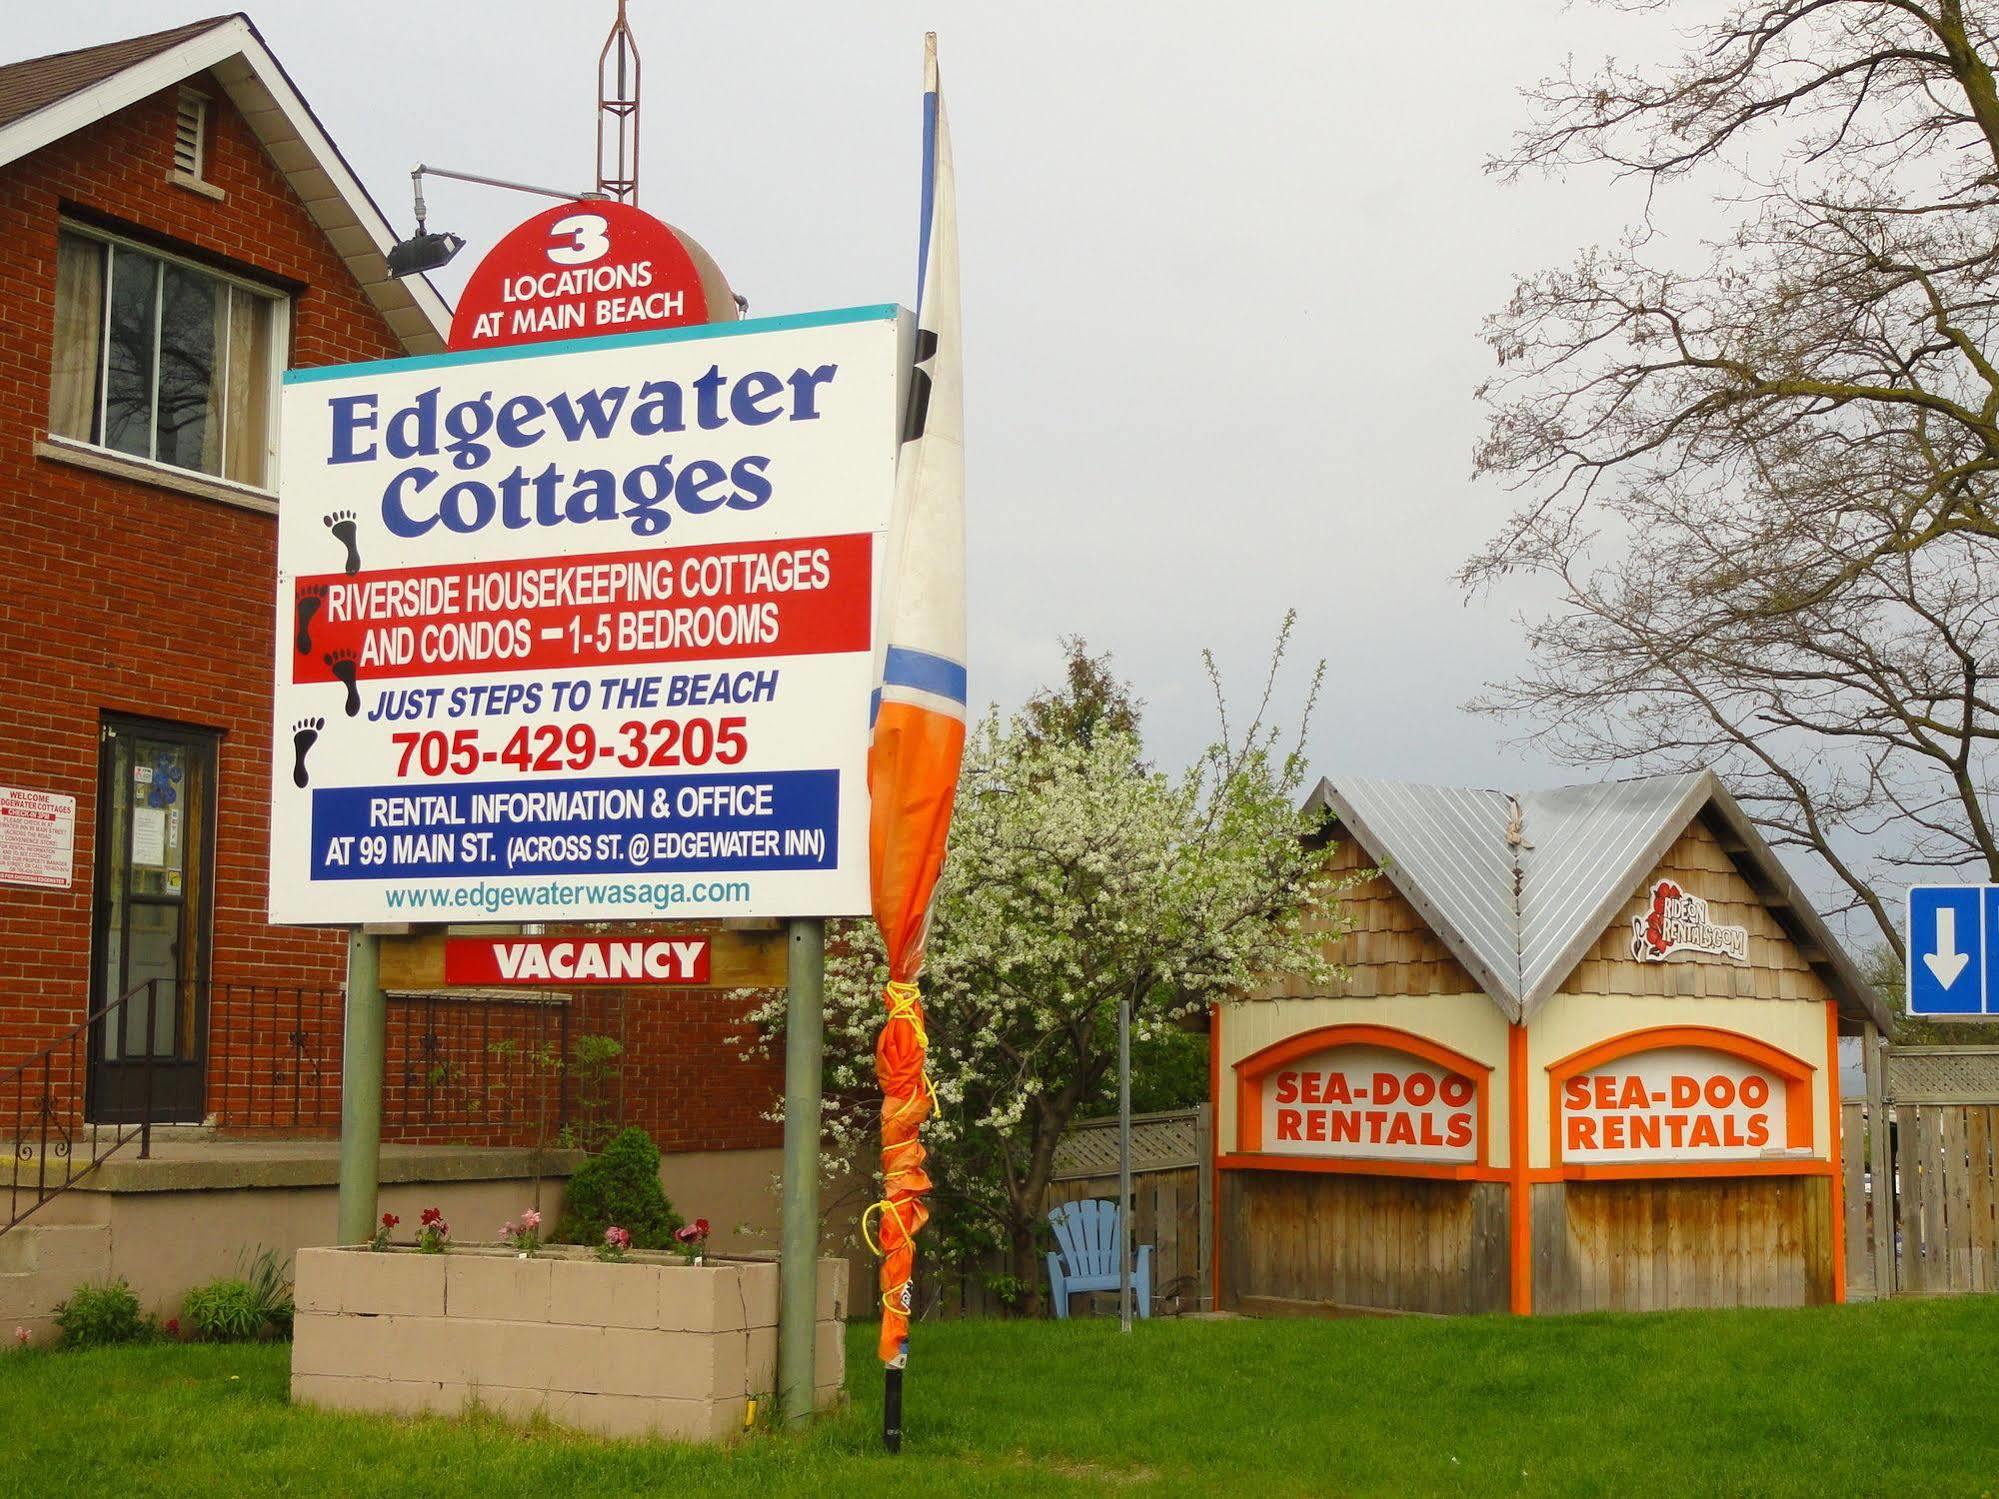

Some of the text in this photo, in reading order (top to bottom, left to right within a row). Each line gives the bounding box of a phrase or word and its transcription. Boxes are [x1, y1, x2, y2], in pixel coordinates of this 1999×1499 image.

[547, 214, 611, 265] 3
[504, 261, 653, 303] LOCATIONS
[472, 290, 684, 339] AT MAIN BEACH
[326, 363, 839, 470] Edgewater
[381, 454, 773, 538] Cottages
[328, 548, 831, 623] RIVERSIDE HOUSEKEEPING COTTAGES
[360, 630, 414, 668] AND
[421, 623, 532, 664] CONDOS
[569, 614, 612, 654] 1-5
[618, 602, 779, 652] BEDROOMS
[368, 670, 779, 722] JUST STEPS TO THE BEACH
[391, 716, 748, 778] 705-429-3205
[0, 798, 71, 813] DGEWATER COTTAGES
[10, 791, 49, 802] WELCOME
[369, 784, 774, 828] RENTAL INFORMATION & OFFICE
[325, 827, 826, 868] AT 99 MAIN ST. (ACROSS ST. @ EDGEWATER INN)
[385, 880, 750, 912] www.edgewaterwasaga.com
[493, 942, 706, 980] VACANCY
[1276, 1071, 1475, 1108] SEA-DOO
[1564, 1074, 1770, 1111] SEA-DOO
[1276, 1110, 1473, 1147] RENTALS
[1566, 1113, 1770, 1151] RENTALS
